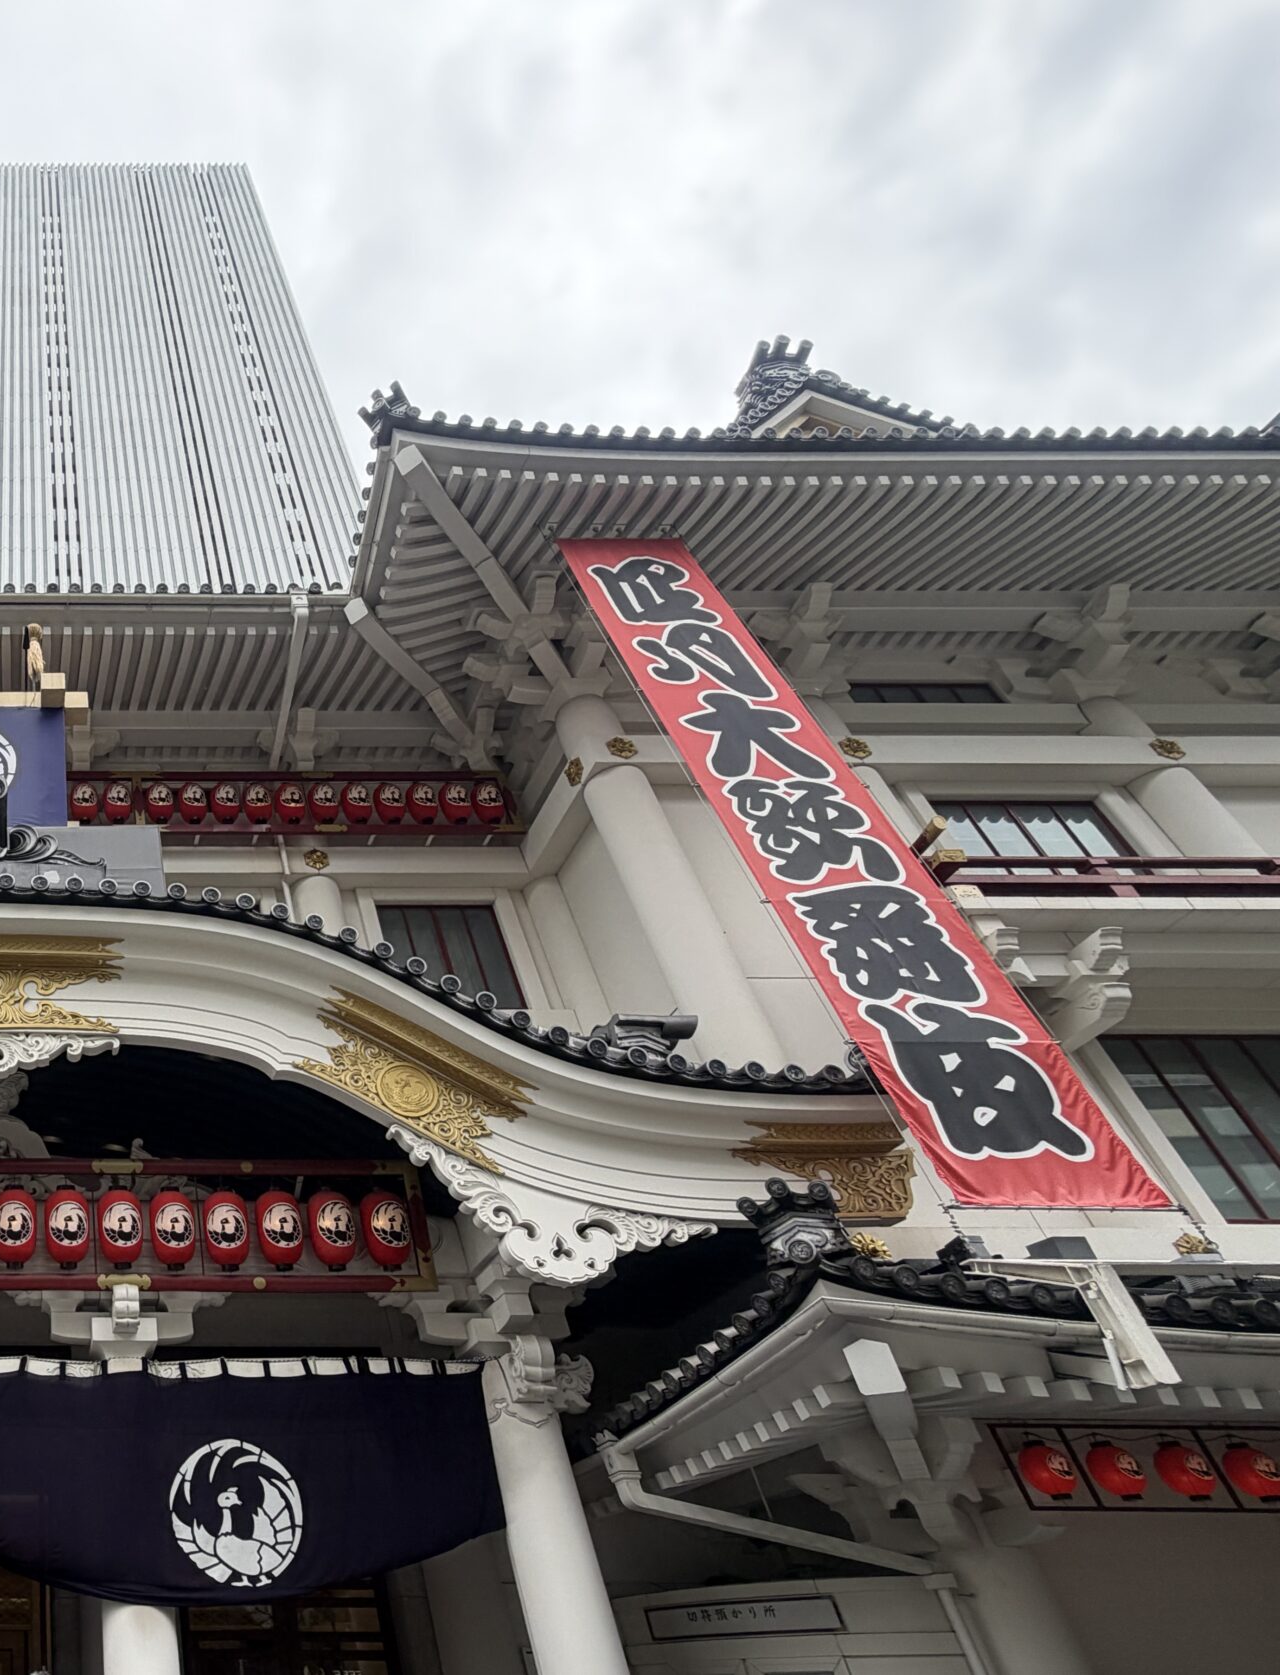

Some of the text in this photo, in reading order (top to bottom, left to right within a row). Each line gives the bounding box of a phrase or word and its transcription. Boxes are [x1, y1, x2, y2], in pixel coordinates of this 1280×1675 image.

[686, 1606, 775, 1622] 切符預かり所
